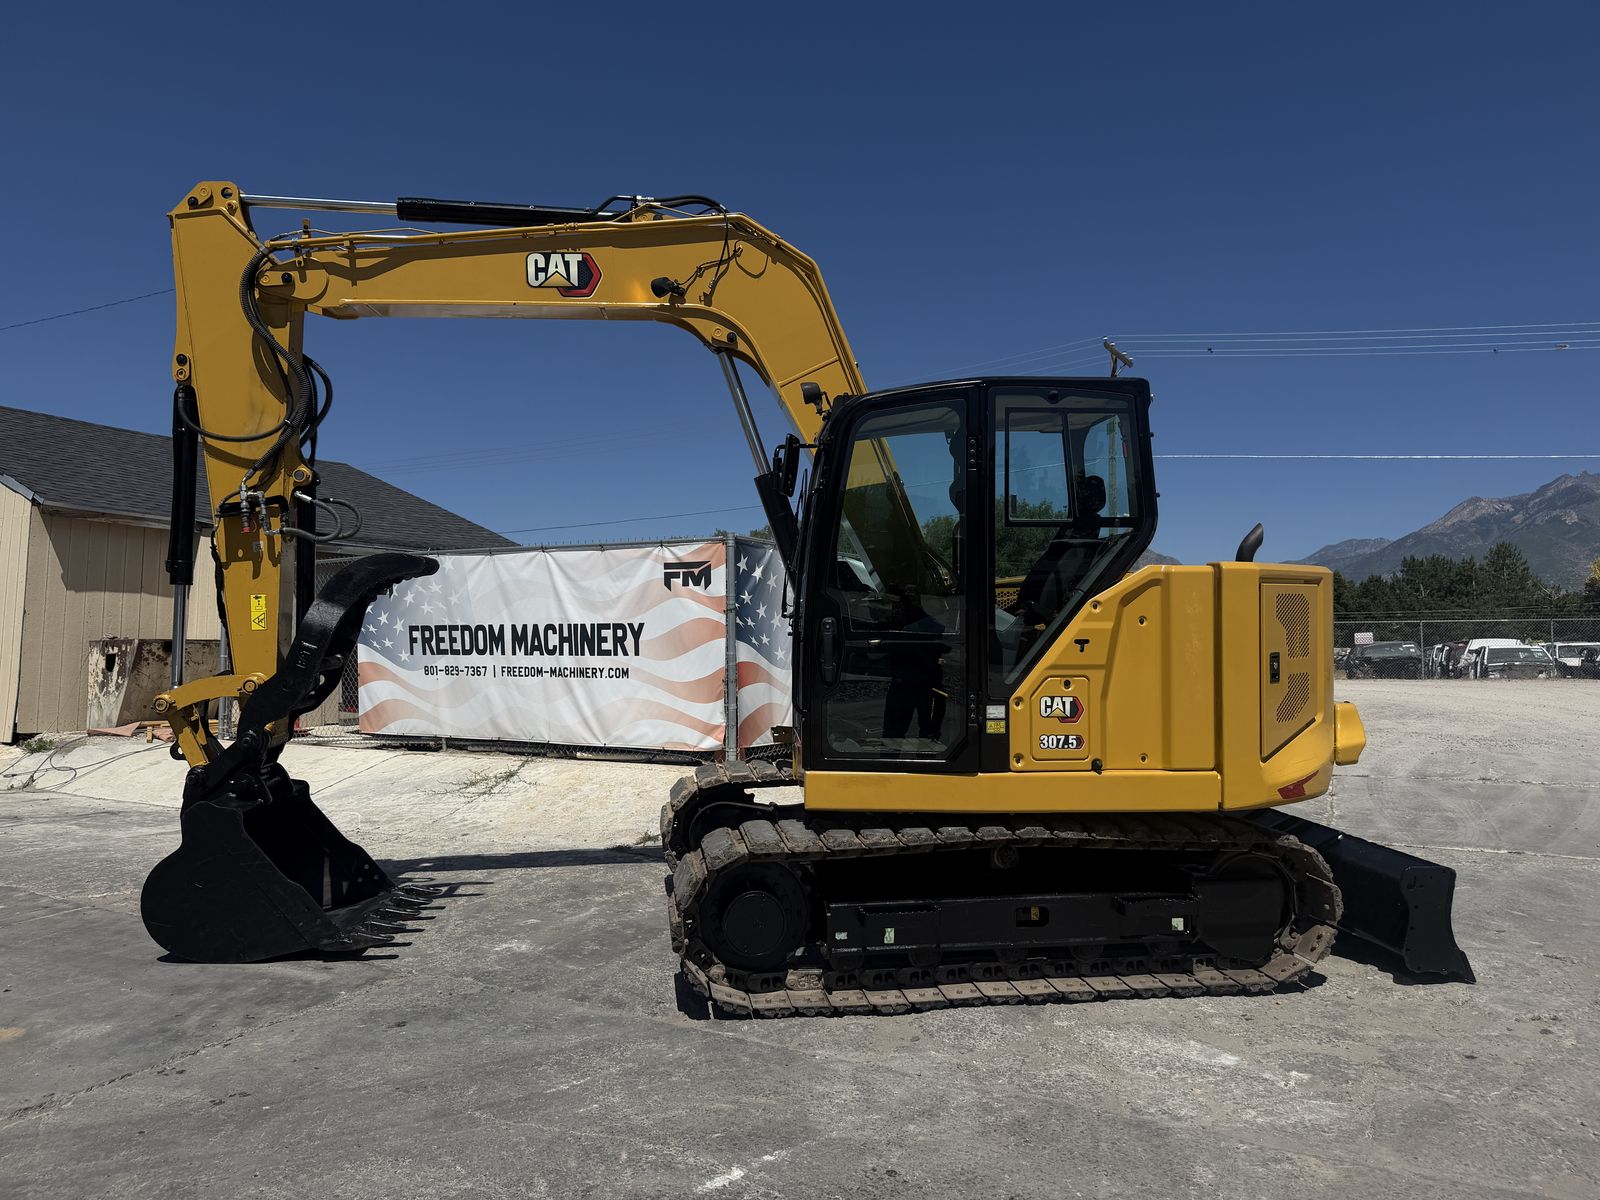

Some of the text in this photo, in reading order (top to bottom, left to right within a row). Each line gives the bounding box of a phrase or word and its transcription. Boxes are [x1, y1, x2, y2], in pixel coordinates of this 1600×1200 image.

[527, 253, 582, 287] CAT
[664, 561, 711, 591] FM
[408, 622, 645, 656] FREEDOM MACHINERY
[424, 665, 487, 677] 801-829-7367
[501, 666, 629, 679] FREEDOM-MACHINERY.COM
[1040, 696, 1073, 718] CAT
[1039, 735, 1077, 749] 307.5
